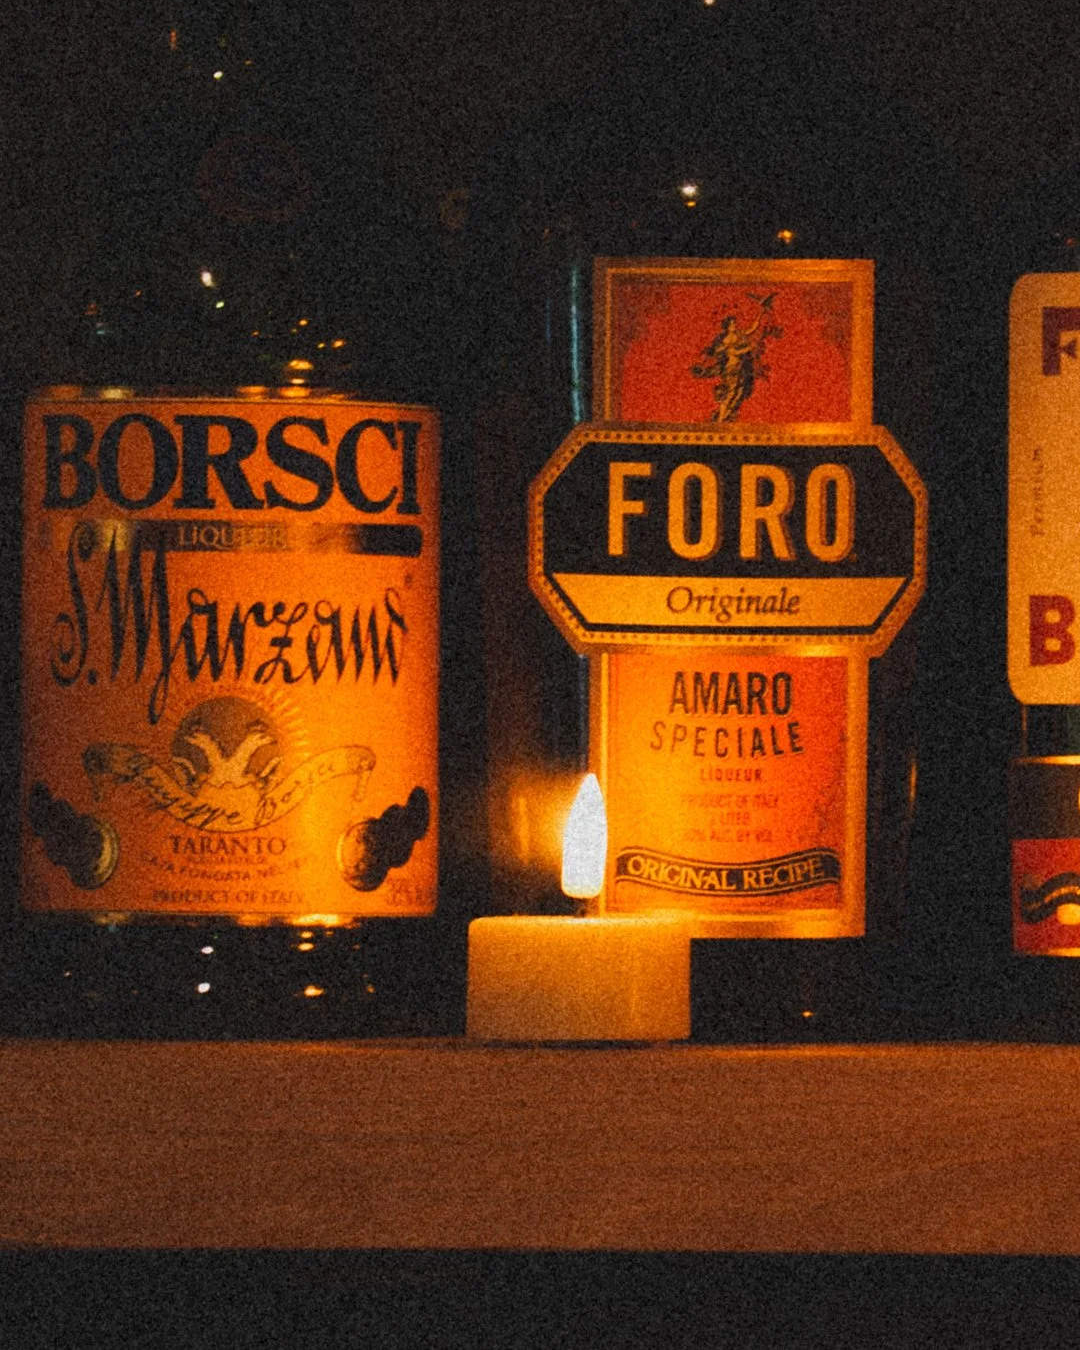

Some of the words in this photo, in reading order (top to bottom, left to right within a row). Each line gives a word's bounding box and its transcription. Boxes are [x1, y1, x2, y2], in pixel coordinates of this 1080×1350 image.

[41, 413, 422, 515] BORSCI
[607, 461, 857, 562] FORO
[666, 586, 801, 624] Originale
[670, 671, 793, 715] AMARO
[650, 721, 804, 758] SPECIALE
[170, 835, 287, 855] TARANTO
[627, 855, 737, 890] ORIGINAL
[742, 857, 826, 890] RECIPE
